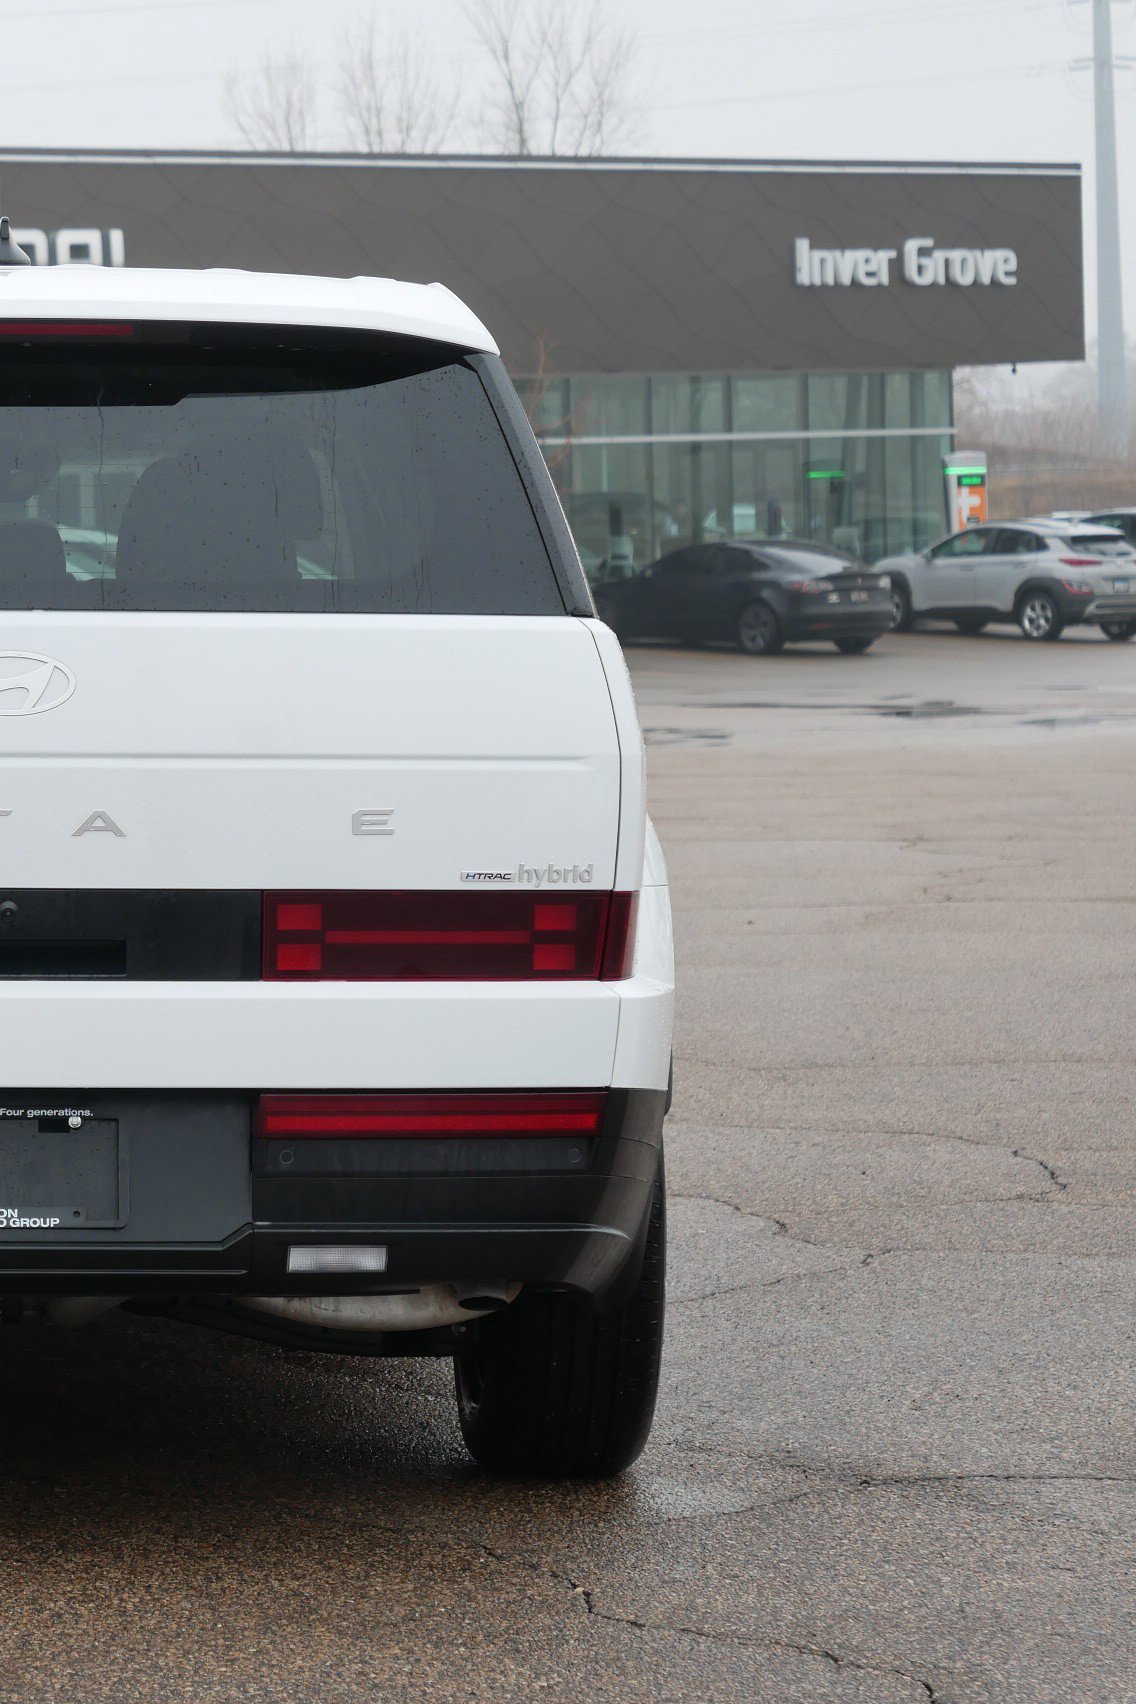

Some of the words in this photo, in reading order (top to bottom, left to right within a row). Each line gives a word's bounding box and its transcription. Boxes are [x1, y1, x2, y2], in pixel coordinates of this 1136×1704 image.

[795, 237, 898, 287] Inver
[903, 237, 1018, 287] Grove
[518, 863, 594, 888] hybrid
[0, 1108, 24, 1116] Four
[26, 1108, 94, 1118] generations.
[9, 1217, 60, 1228] GROUP
